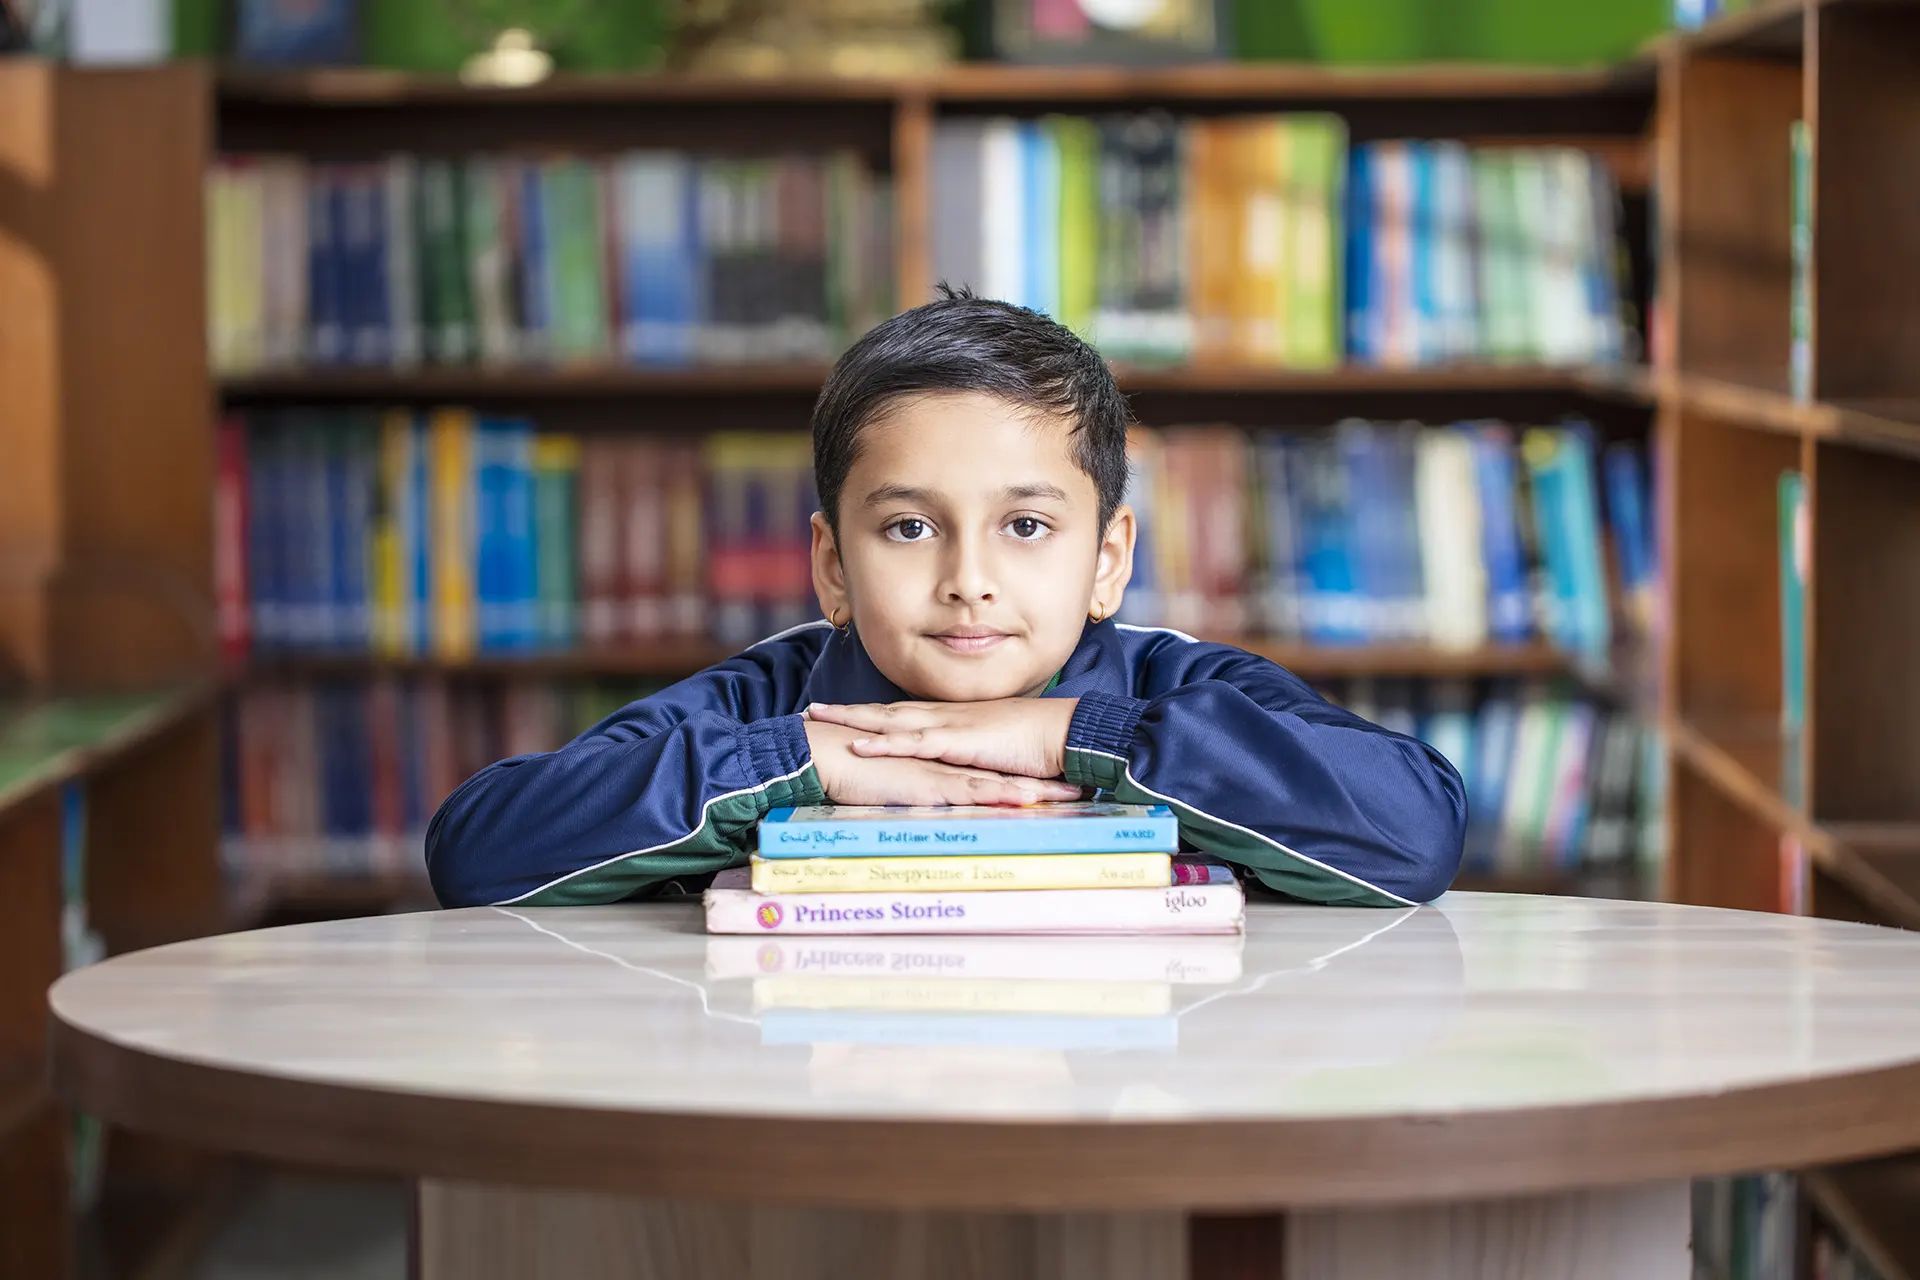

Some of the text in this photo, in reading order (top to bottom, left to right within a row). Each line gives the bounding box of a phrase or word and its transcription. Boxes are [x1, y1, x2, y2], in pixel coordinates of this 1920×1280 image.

[878, 830, 979, 843] Bedtime Stories
[1114, 829, 1156, 840] AWARD
[868, 864, 1015, 883] Sleepytime Tales
[794, 899, 966, 922] Princess Stories
[1165, 890, 1207, 913] igloo
